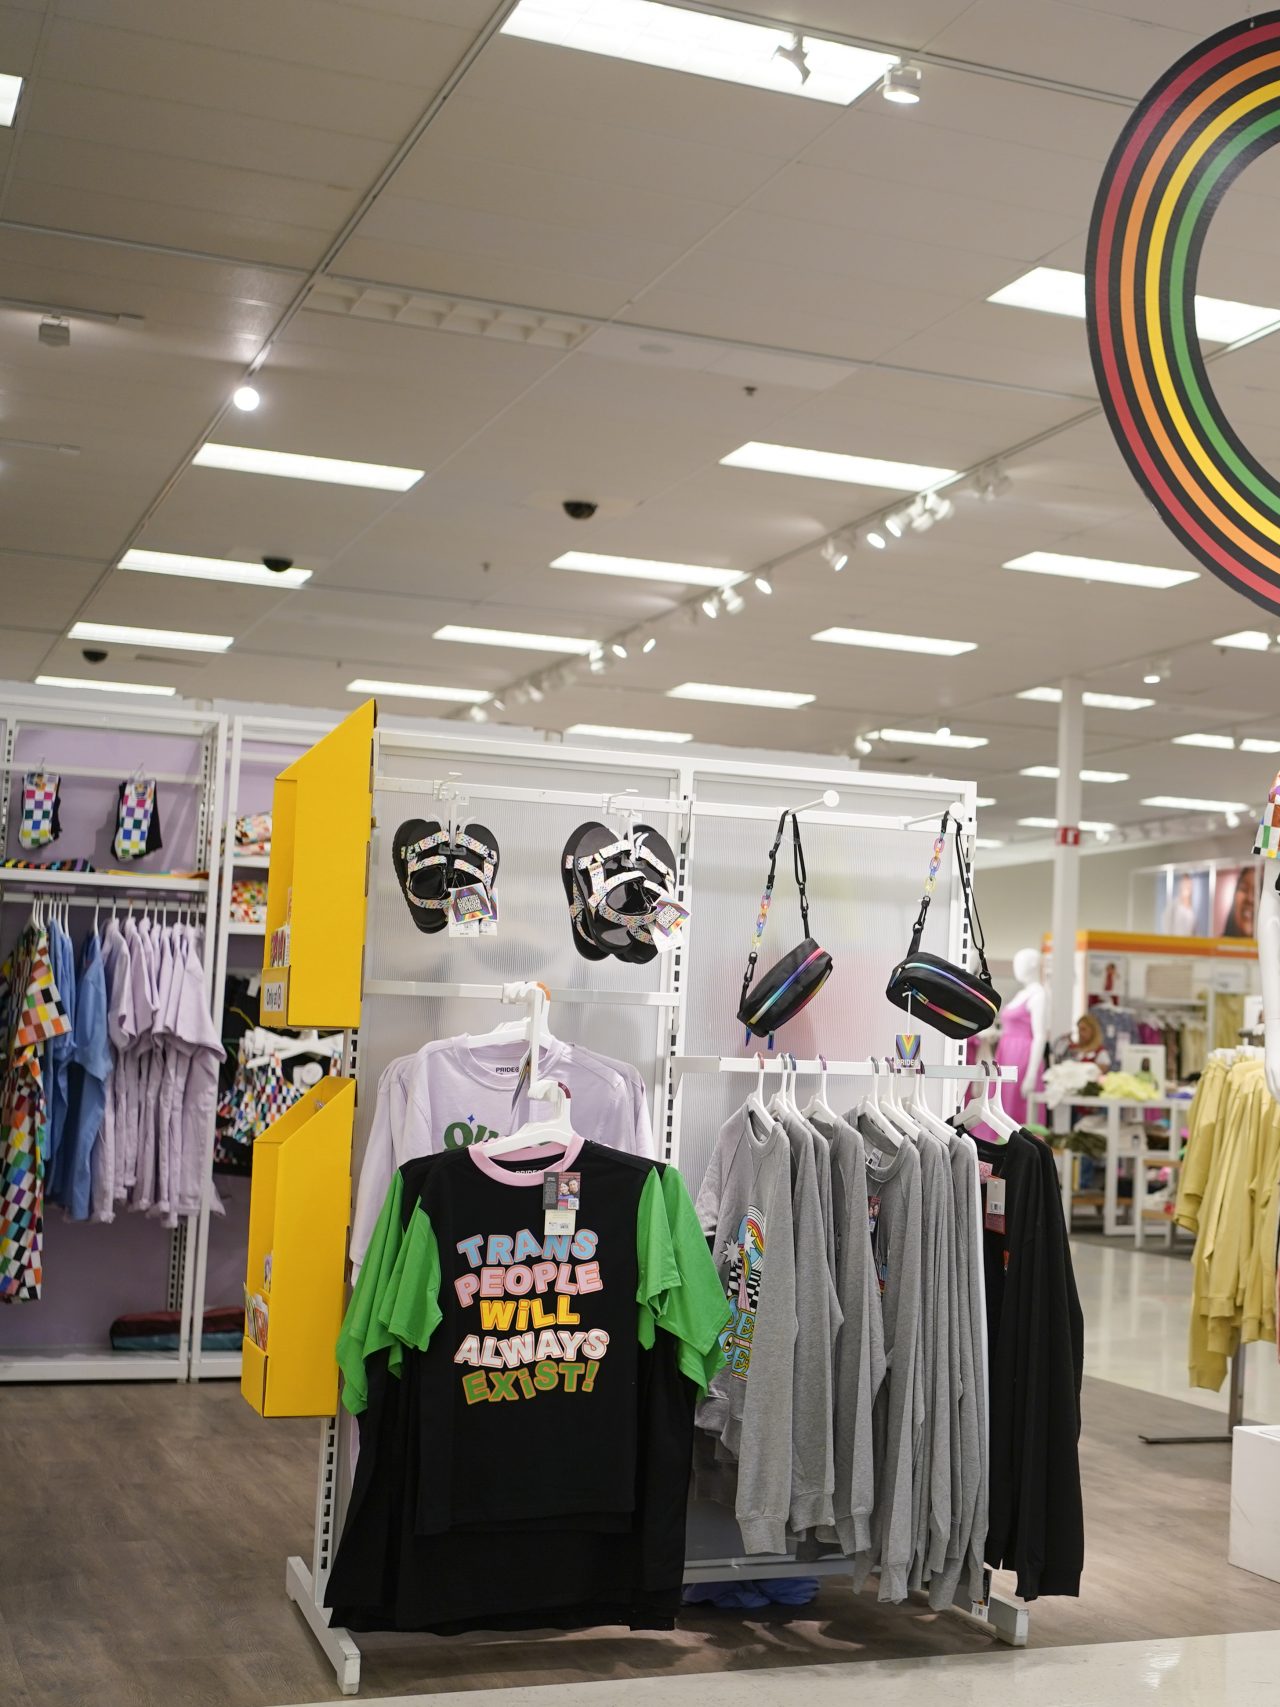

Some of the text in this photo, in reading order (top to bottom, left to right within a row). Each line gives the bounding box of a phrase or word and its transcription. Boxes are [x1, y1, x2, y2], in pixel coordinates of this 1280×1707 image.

[456, 1229, 599, 1268] TRANS
[454, 1261, 603, 1308] PEOPLE
[454, 1328, 610, 1369] ALWAYS
